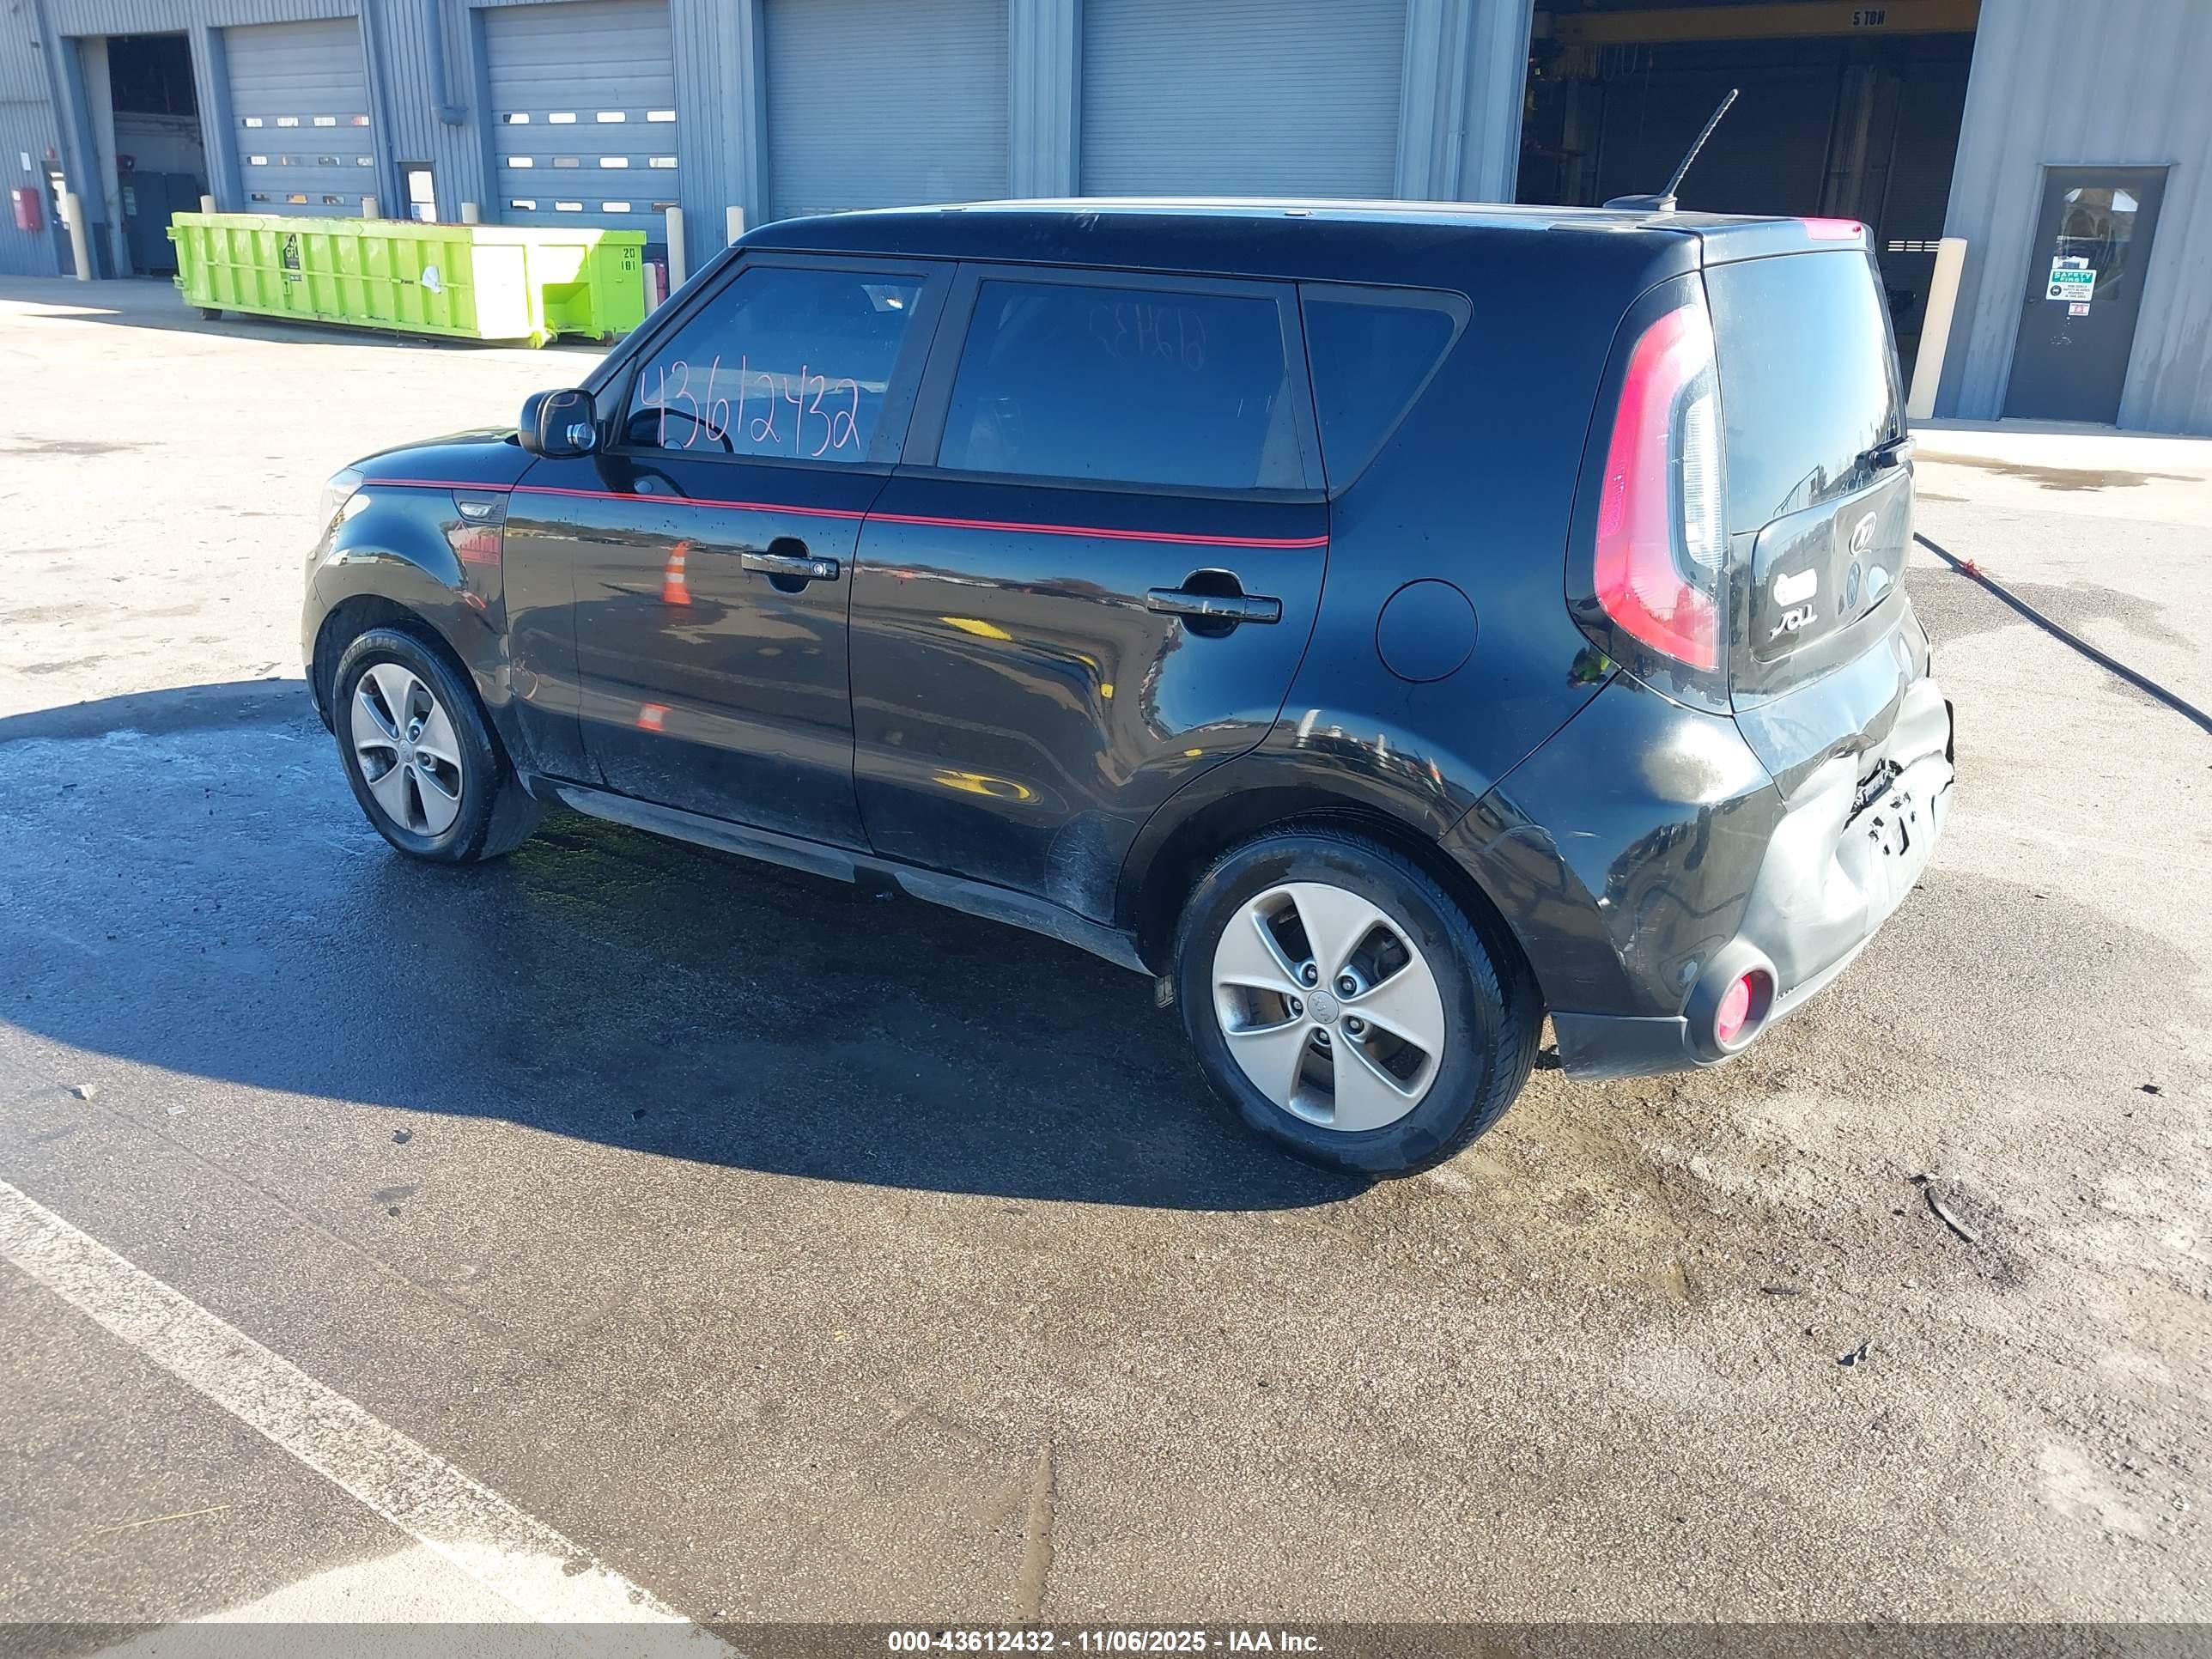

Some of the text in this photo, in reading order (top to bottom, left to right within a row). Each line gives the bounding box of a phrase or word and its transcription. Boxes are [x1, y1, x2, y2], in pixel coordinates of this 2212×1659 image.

[1852, 10, 1886, 26] 5 TON
[623, 247, 635, 258] 20
[641, 355, 860, 457] 43612432
